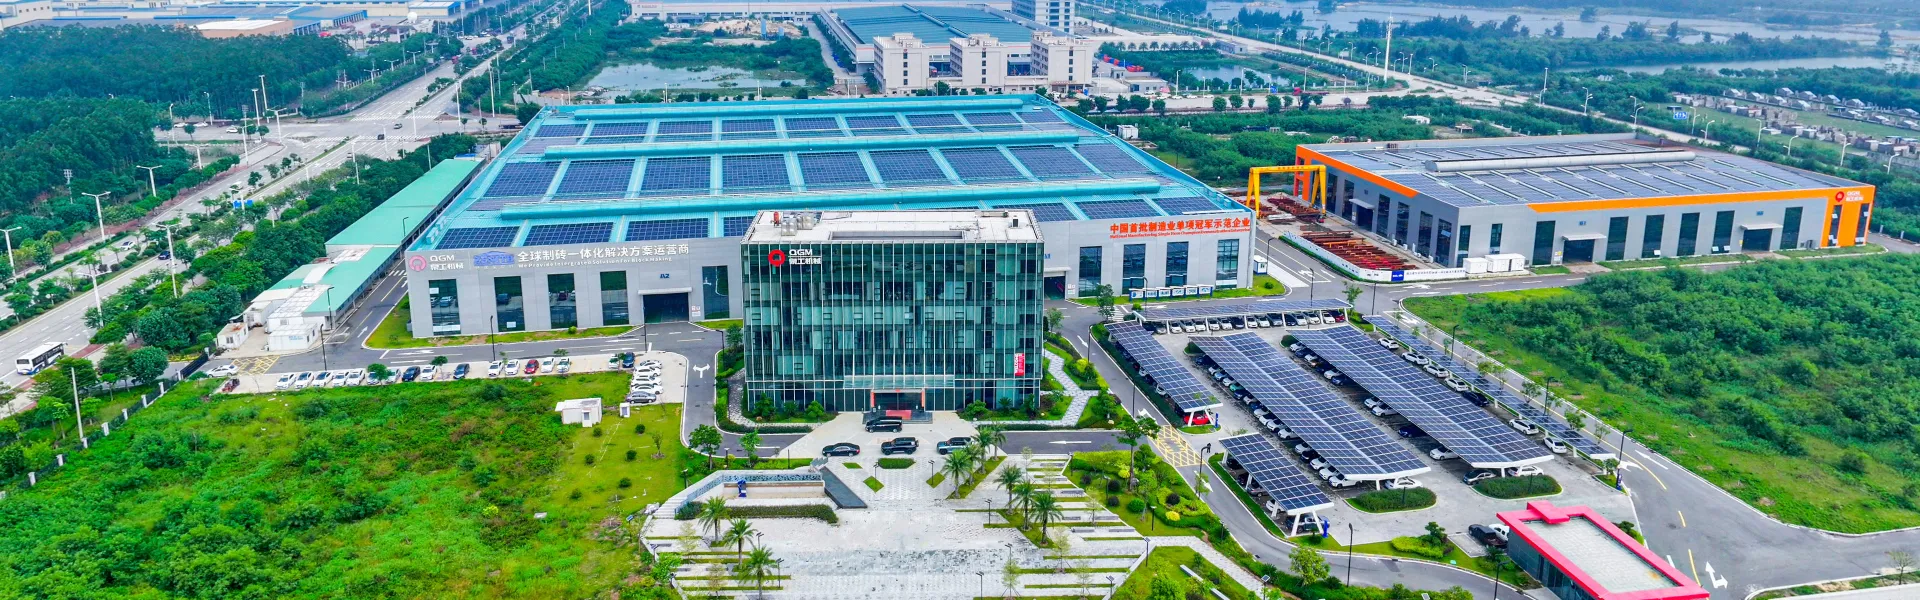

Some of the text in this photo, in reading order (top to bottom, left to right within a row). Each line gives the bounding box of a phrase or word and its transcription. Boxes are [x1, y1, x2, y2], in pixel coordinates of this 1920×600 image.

[1110, 217, 1251, 234] 中国首批制造业单项冠军示范企业
[429, 254, 455, 262] QGM
[517, 244, 689, 263] 全球制砖一体化解决方案运营商
[789, 248, 813, 256] QGM
